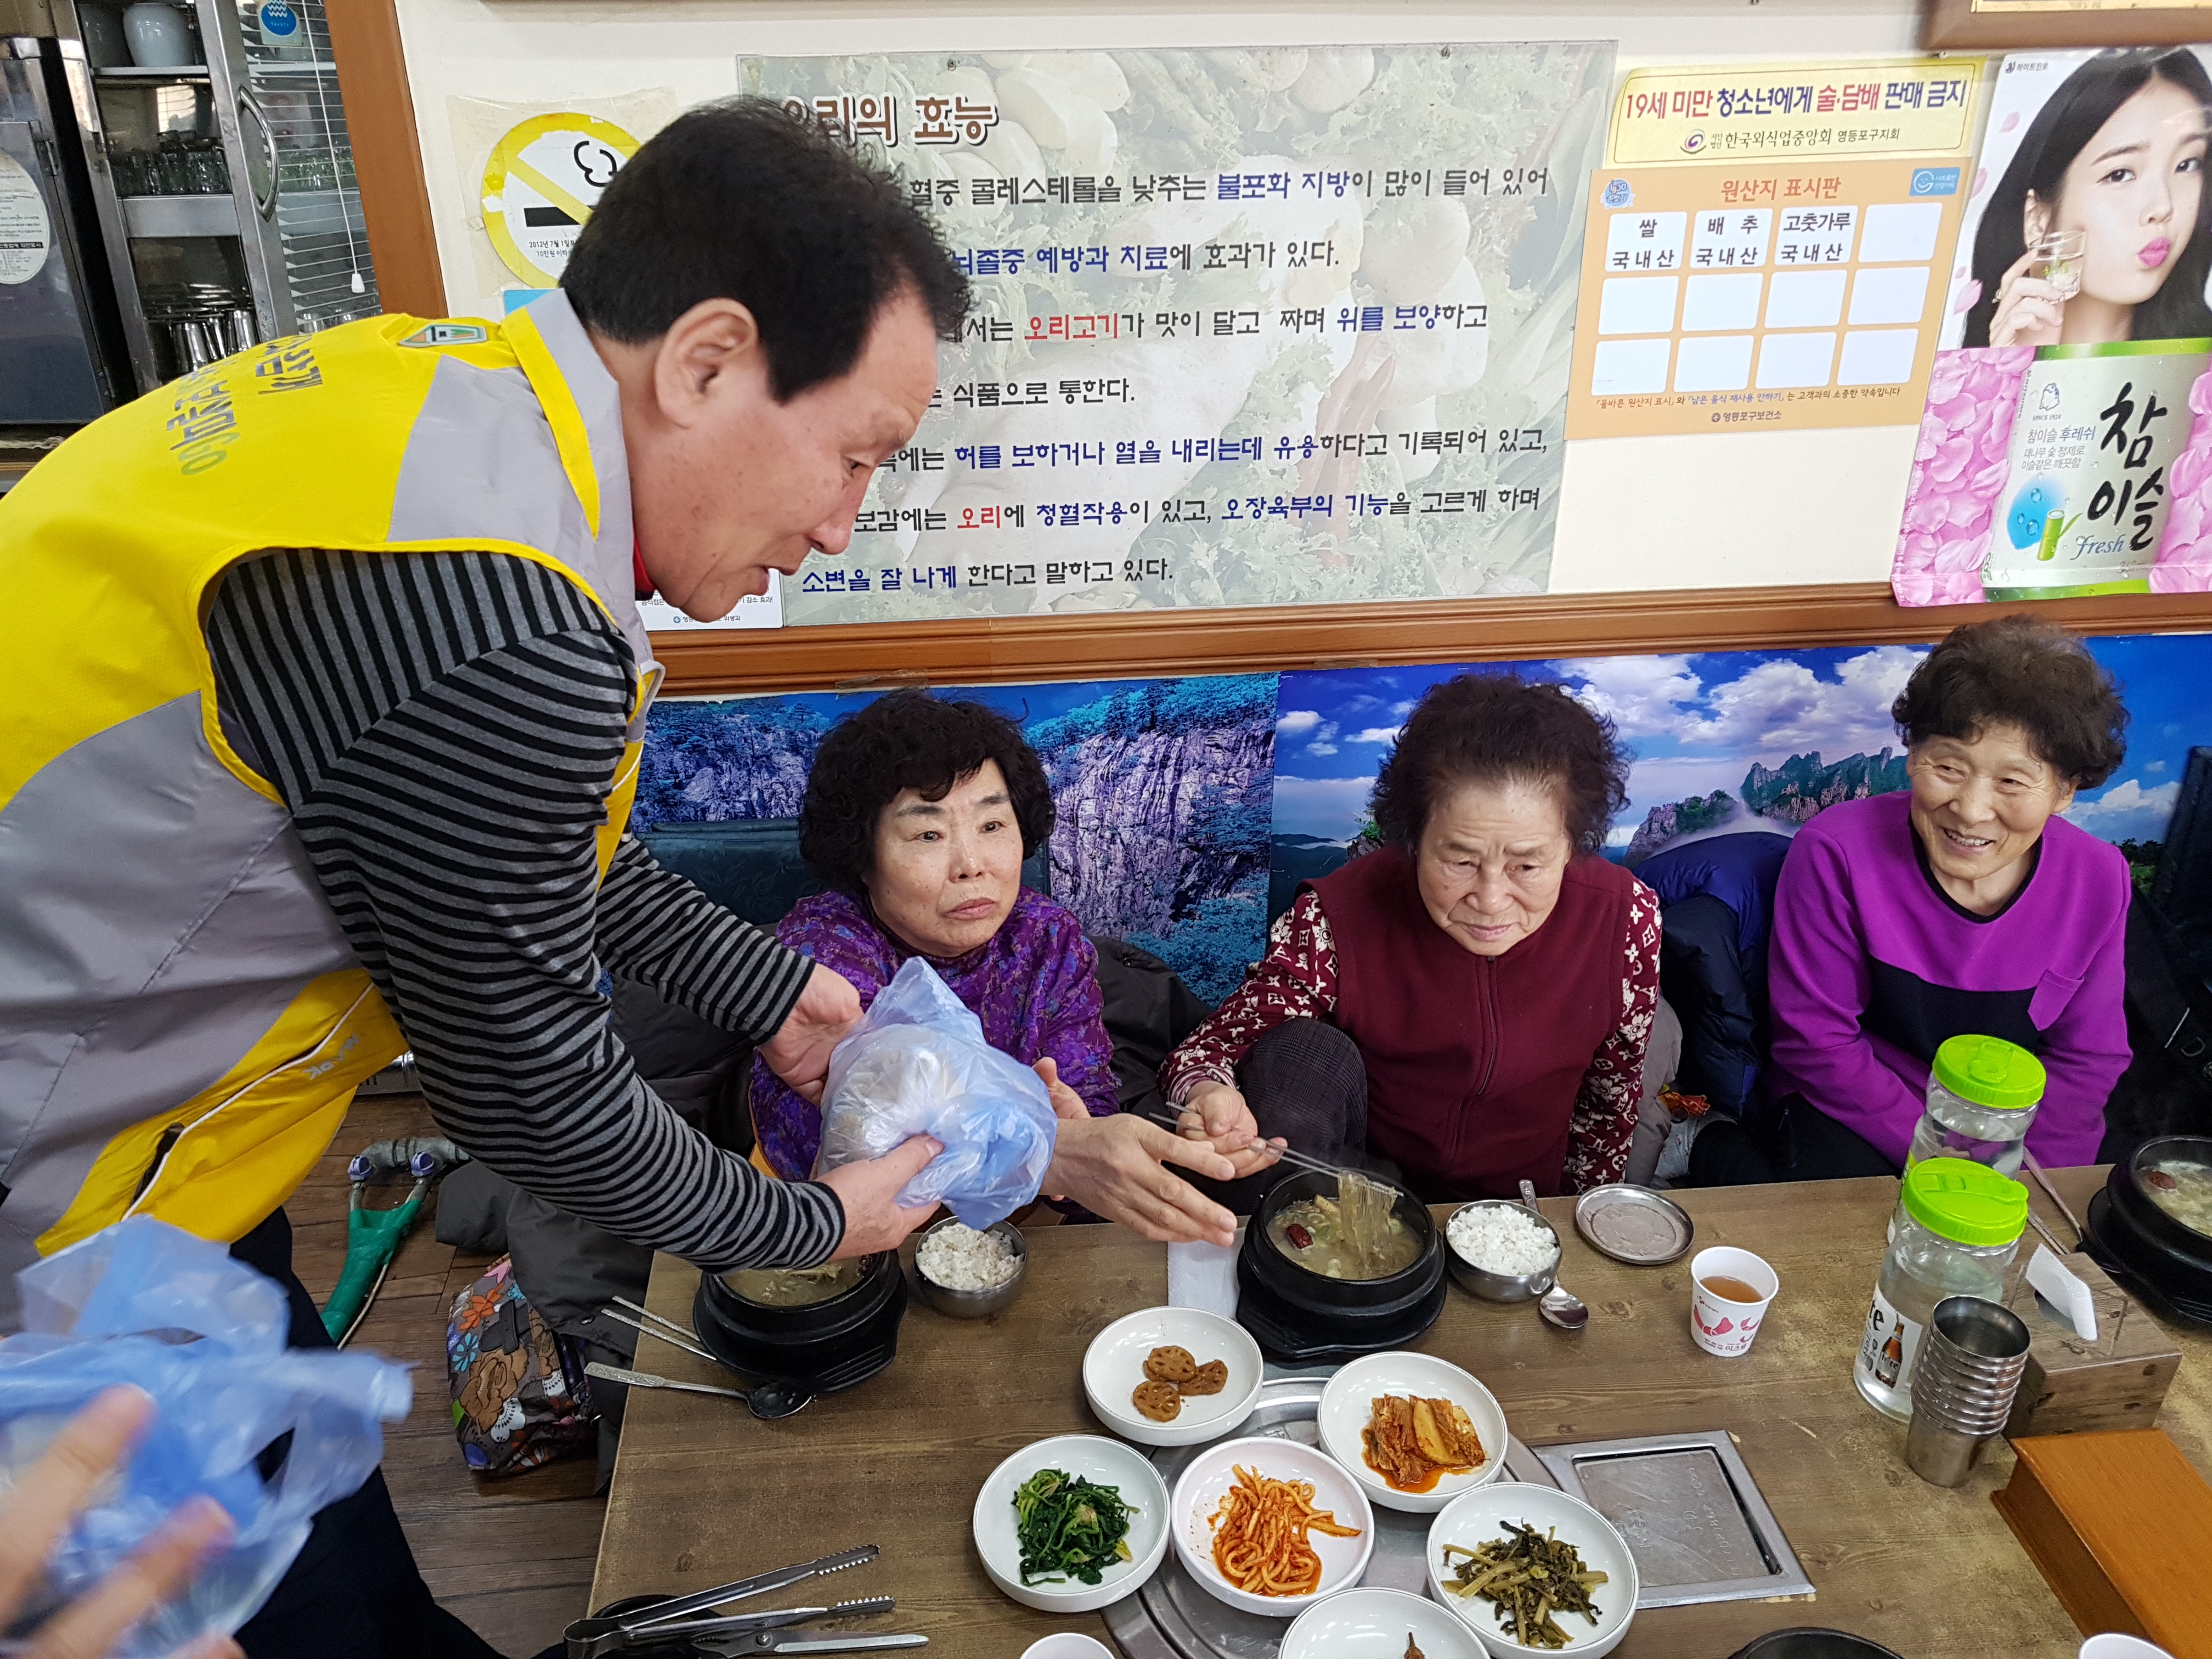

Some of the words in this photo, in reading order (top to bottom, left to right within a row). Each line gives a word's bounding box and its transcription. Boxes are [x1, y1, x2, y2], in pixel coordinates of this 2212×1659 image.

[1626, 91, 1667, 119] 19세
[1672, 89, 1713, 117] 미만
[1716, 86, 1813, 117] 청소년에게
[1885, 81, 1925, 109] 판매
[1926, 80, 1968, 108] 금지
[914, 96, 993, 139] 효능
[1725, 128, 1832, 149] 한국외식업중앙회
[1838, 127, 1900, 143] 영등포구지회
[910, 179, 961, 206] 혈중
[1132, 175, 1206, 202] 낮추는
[1217, 172, 1291, 200] 불포화
[1302, 170, 1372, 199] 지방이
[1385, 168, 1431, 197] 많이
[1443, 167, 1490, 195] 들어
[1502, 167, 1549, 195] 있어
[1721, 180, 1778, 202] 원산지
[1784, 177, 1842, 199] 표시판
[1639, 218, 1658, 238] 쌀
[1783, 213, 1851, 233] 고춧가루
[952, 248, 1025, 275] 뇌졸중
[1036, 245, 1109, 274] 예방과
[1120, 244, 1191, 272] 치료에
[1204, 242, 1276, 269] 효과가
[1287, 240, 1340, 268] 있다.
[1024, 312, 1144, 341] 오리고기가
[1155, 311, 1201, 337] 맛이
[1213, 310, 1261, 336] 달고
[1280, 307, 1324, 334] 짜며
[1337, 306, 1384, 332] 위를
[1393, 303, 1488, 331] 보양하고
[953, 382, 1049, 408] 식품으로
[1059, 379, 1135, 405] 통한다.
[1629, 397, 1652, 408] 원산지
[1676, 396, 1685, 405] 와
[1730, 393, 1754, 404] 재사용
[1787, 392, 1795, 402] 는
[1798, 390, 1831, 400] 고객과의
[1833, 389, 1858, 399] 소중한
[1860, 387, 1901, 398] 약속입니다
[1723, 411, 1782, 422] 영등포구보건소
[2028, 427, 2057, 444] 참이슬
[2059, 426, 2097, 442] 후레쉬
[955, 445, 1002, 470] 허를
[1012, 442, 1105, 468] 보하거나
[1115, 439, 1161, 465] 열을
[1172, 437, 1262, 463] 내리는데
[1274, 433, 1387, 460] 유용하다고
[1399, 430, 1487, 457] 기록되어
[1499, 428, 1548, 455] 있고,
[2024, 447, 2046, 458] 대나무
[2058, 445, 2085, 457] 정제로
[2022, 459, 2052, 471] 이슬같은
[2053, 458, 2081, 469] 깨끗함
[957, 505, 1025, 529] 오리에
[1036, 500, 1149, 528] 청혈작용이
[1160, 498, 1212, 524] 있고,
[1221, 494, 1333, 521] 오장육부의
[1345, 492, 1411, 517] 기능을
[1420, 489, 1487, 514] 고르게
[1498, 486, 1540, 511] 하며
[2070, 534, 2126, 560] fresh
[802, 569, 871, 594] 소변을
[881, 567, 902, 591] 잘
[912, 566, 957, 590] 나게
[968, 563, 1036, 588] 한다고
[1046, 560, 1114, 585] 말하고
[1124, 557, 1174, 583] 있다.
